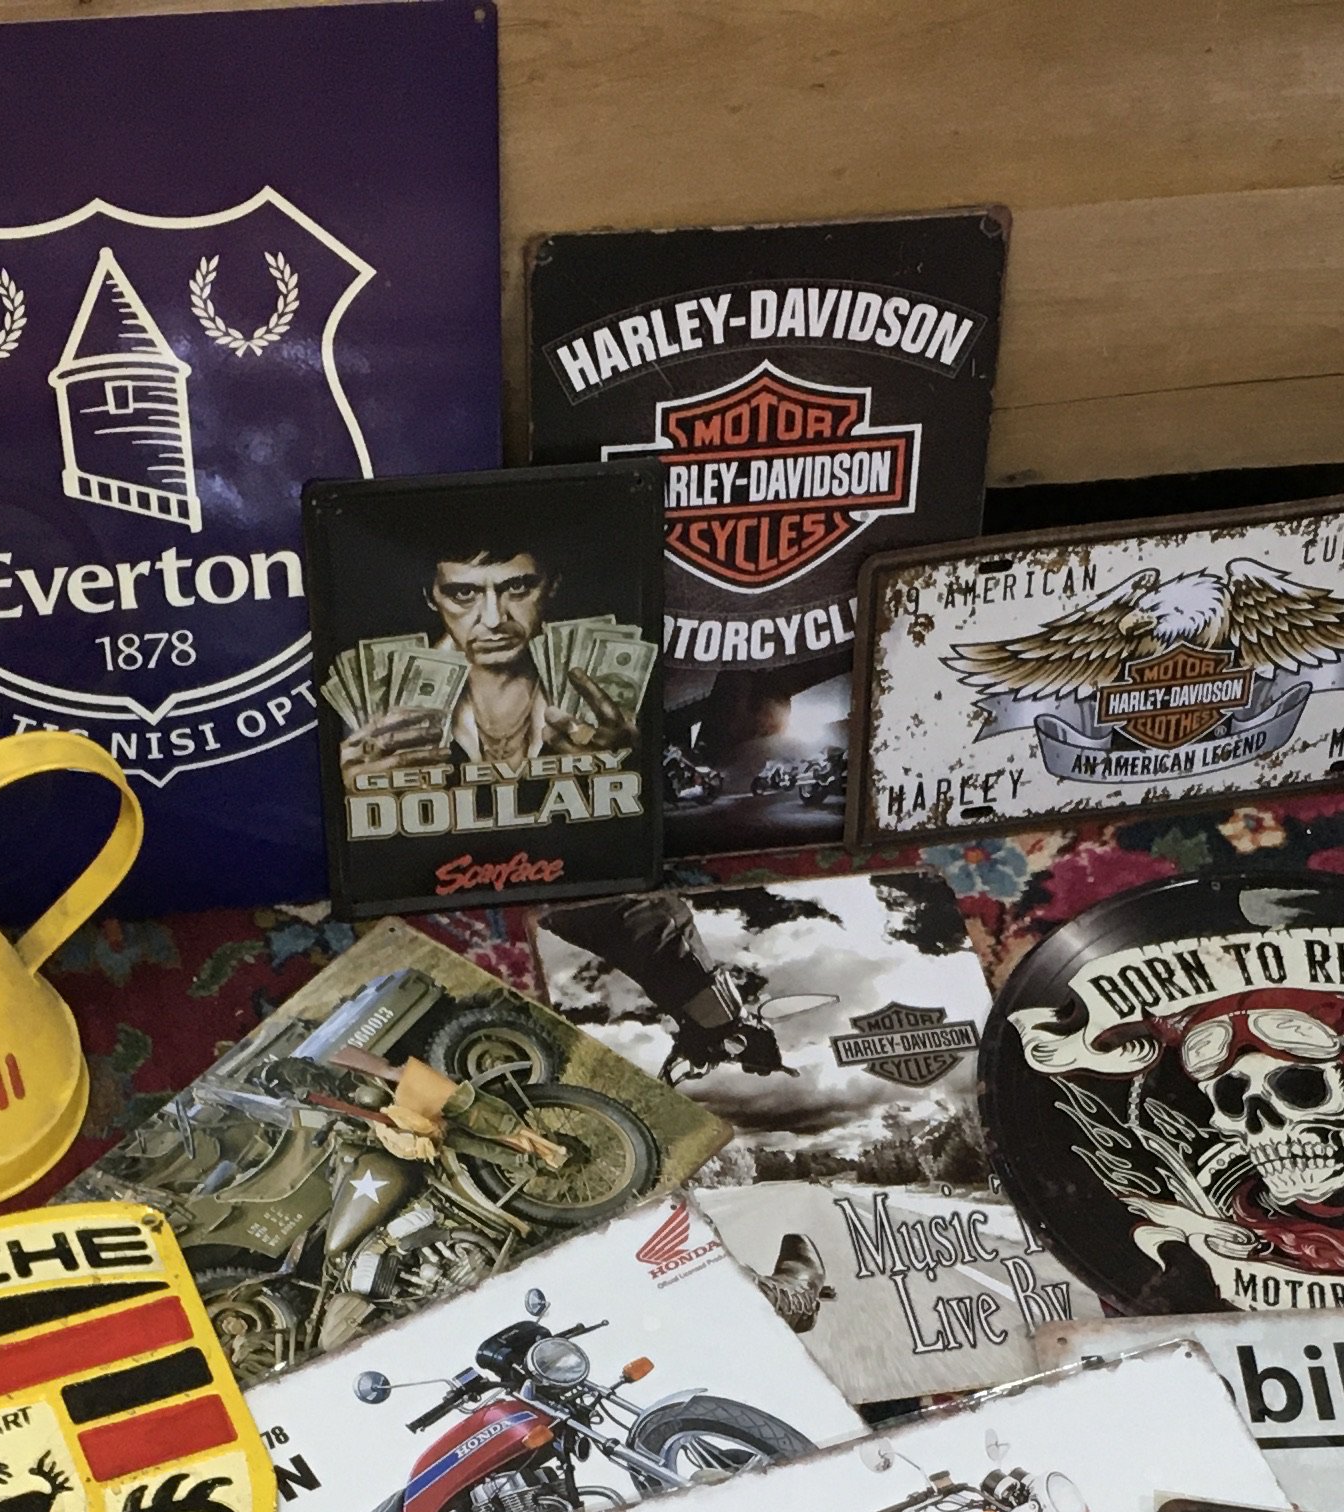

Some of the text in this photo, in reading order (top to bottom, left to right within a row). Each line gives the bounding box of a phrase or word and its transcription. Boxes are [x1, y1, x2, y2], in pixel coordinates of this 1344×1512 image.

[556, 287, 973, 394] HARLEY-DAVIDSON
[694, 390, 833, 448] MOTOR
[664, 451, 892, 508] RLEY-DAVIDSON
[689, 513, 826, 572] CYCLES
[944, 563, 1097, 610] AMERICAN
[95, 629, 197, 672] 1878
[1143, 657, 1215, 683] MOTOR
[1108, 678, 1244, 715] HARLEY-DAVIDSON
[111, 722, 221, 760] NISI
[1071, 731, 1267, 777] AN AMERICAN LEGEND
[354, 748, 633, 790] GET EVERY
[345, 771, 644, 841] DOLLAR
[887, 769, 1025, 815] HARLEY
[435, 852, 564, 896] Scarface
[1088, 947, 1216, 1021] BORN
[1222, 940, 1288, 988] TO
[842, 1027, 973, 1060] HARLEY-DAVIDSON
[867, 1009, 936, 1033] MOTOR
[879, 1053, 949, 1082] CYCLES
[834, 1182, 999, 1280] Music
[648, 1240, 723, 1281] HONDA
[893, 1266, 1009, 1355] Live
[455, 1420, 512, 1460] HONDA
